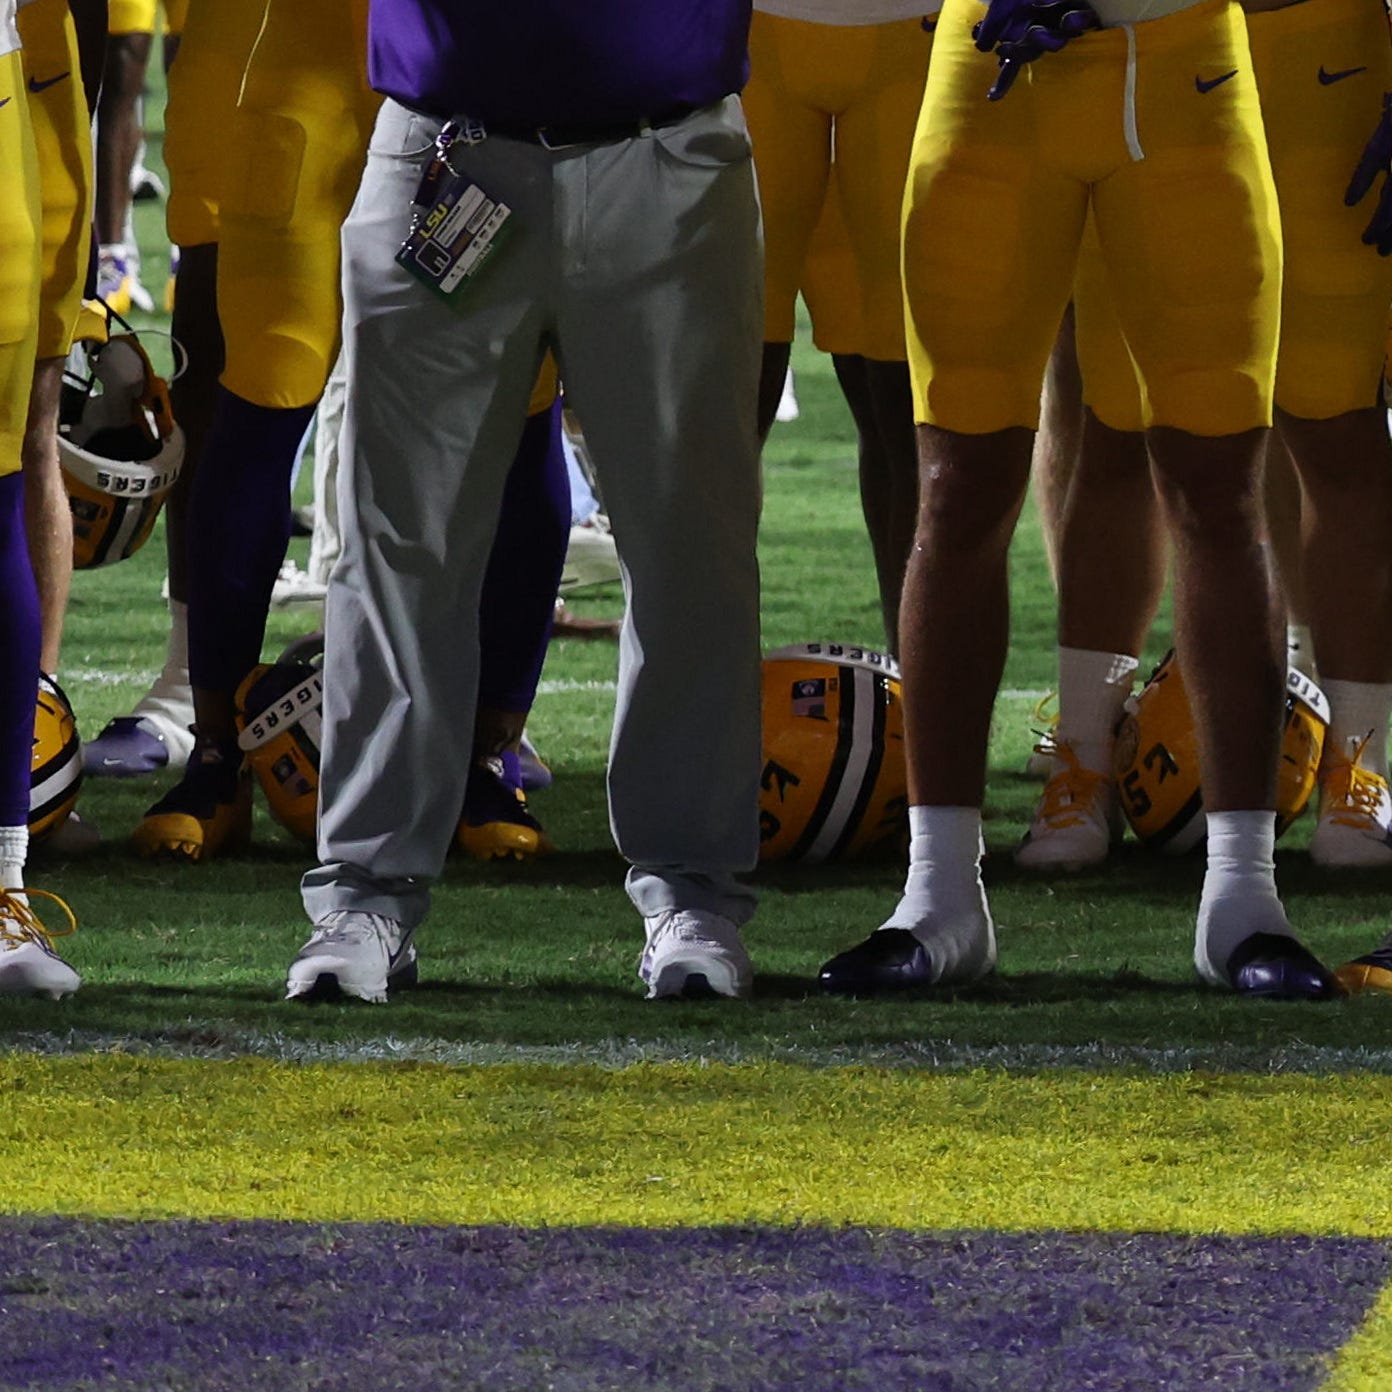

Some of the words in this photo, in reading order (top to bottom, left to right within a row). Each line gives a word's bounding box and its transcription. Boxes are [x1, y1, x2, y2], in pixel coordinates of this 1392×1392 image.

[419, 203, 449, 239] LSU
[806, 643, 894, 669] IGERS
[251, 679, 323, 741] IGERS
